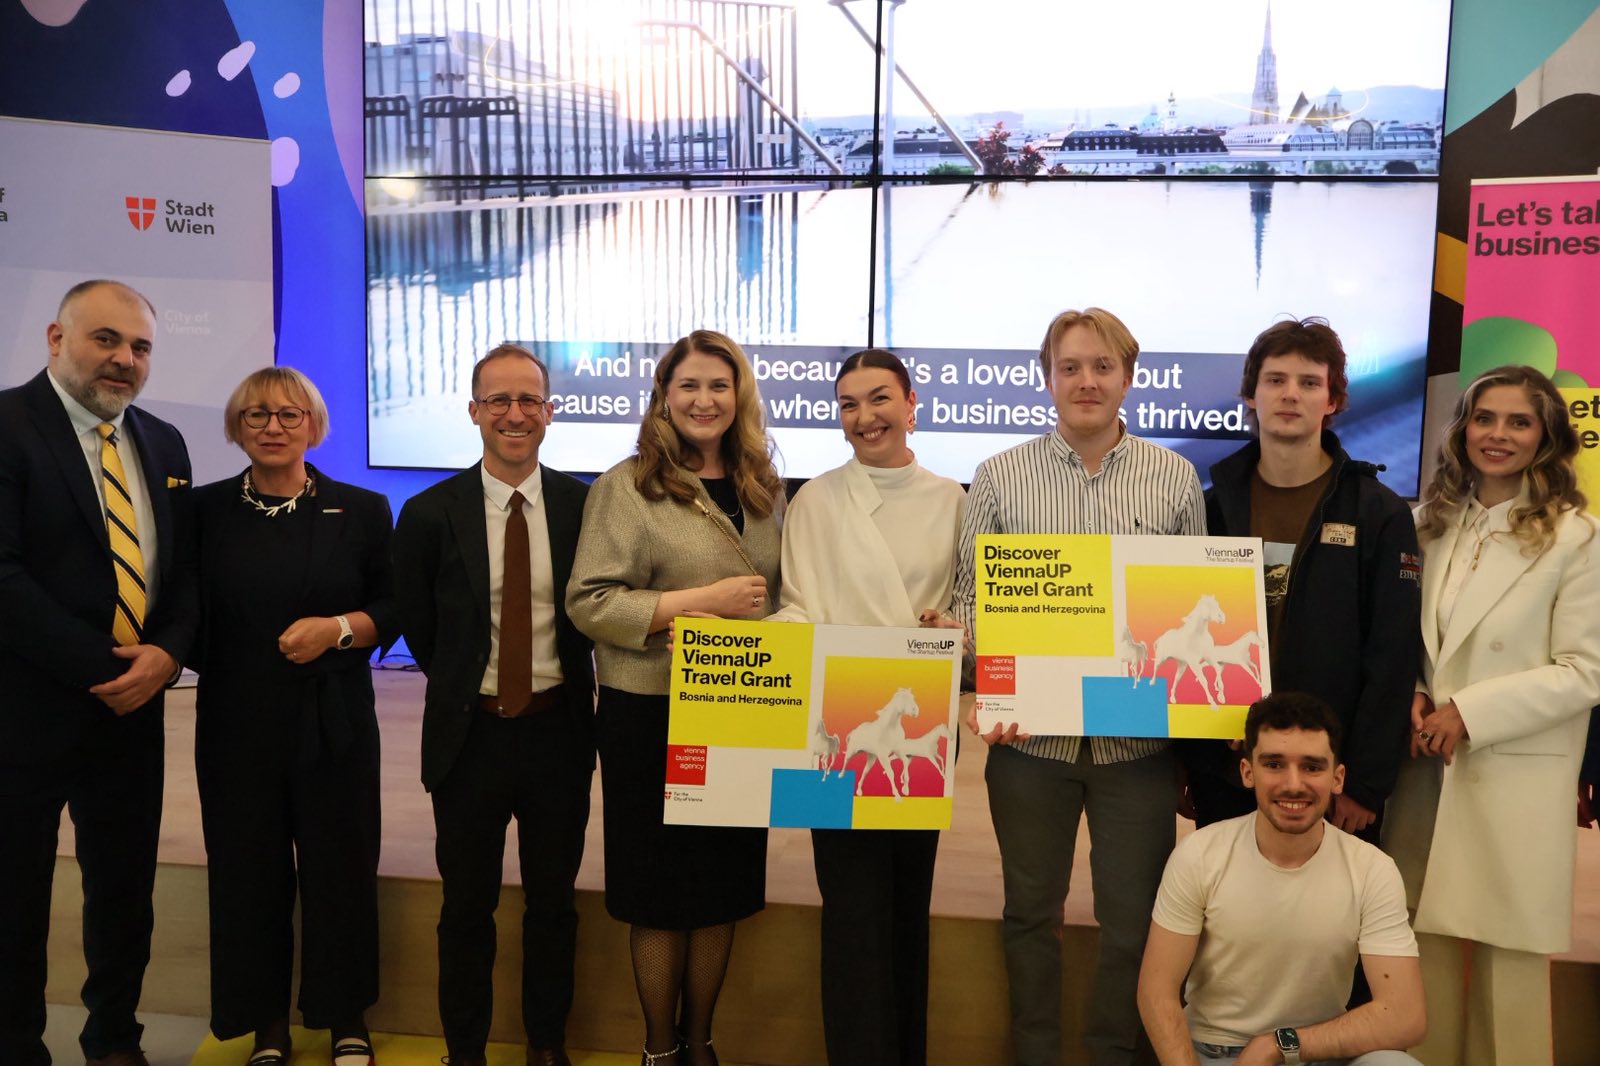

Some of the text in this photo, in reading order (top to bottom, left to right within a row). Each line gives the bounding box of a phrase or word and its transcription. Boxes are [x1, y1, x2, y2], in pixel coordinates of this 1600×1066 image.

[165, 199, 214, 217] Stadt
[1476, 201, 1552, 226] Let's
[165, 217, 214, 235] Wien
[164, 310, 208, 324] City of
[166, 322, 211, 336] Vienna
[574, 351, 630, 377] And
[754, 354, 841, 382] becau
[940, 364, 958, 384] a
[968, 358, 1047, 392] lovely
[1132, 362, 1182, 389] but
[552, 394, 630, 416] cause
[770, 394, 839, 420] wher
[932, 396, 1058, 426] business
[1136, 402, 1250, 430] thrived.
[1569, 394, 1600, 419] et
[984, 546, 1061, 560] Discover
[1205, 547, 1254, 558] ViennaUP
[985, 563, 1072, 578] ViennaUP
[985, 582, 1094, 596] Travel Grant
[985, 604, 1106, 615] Bosnia and Herzegovina
[682, 629, 762, 648] Discover
[907, 639, 954, 650] ViennaUP
[682, 648, 772, 668] ViennaUP
[681, 668, 792, 688] Travel Grant
[679, 691, 802, 706] Bosnia and Herzegovina
